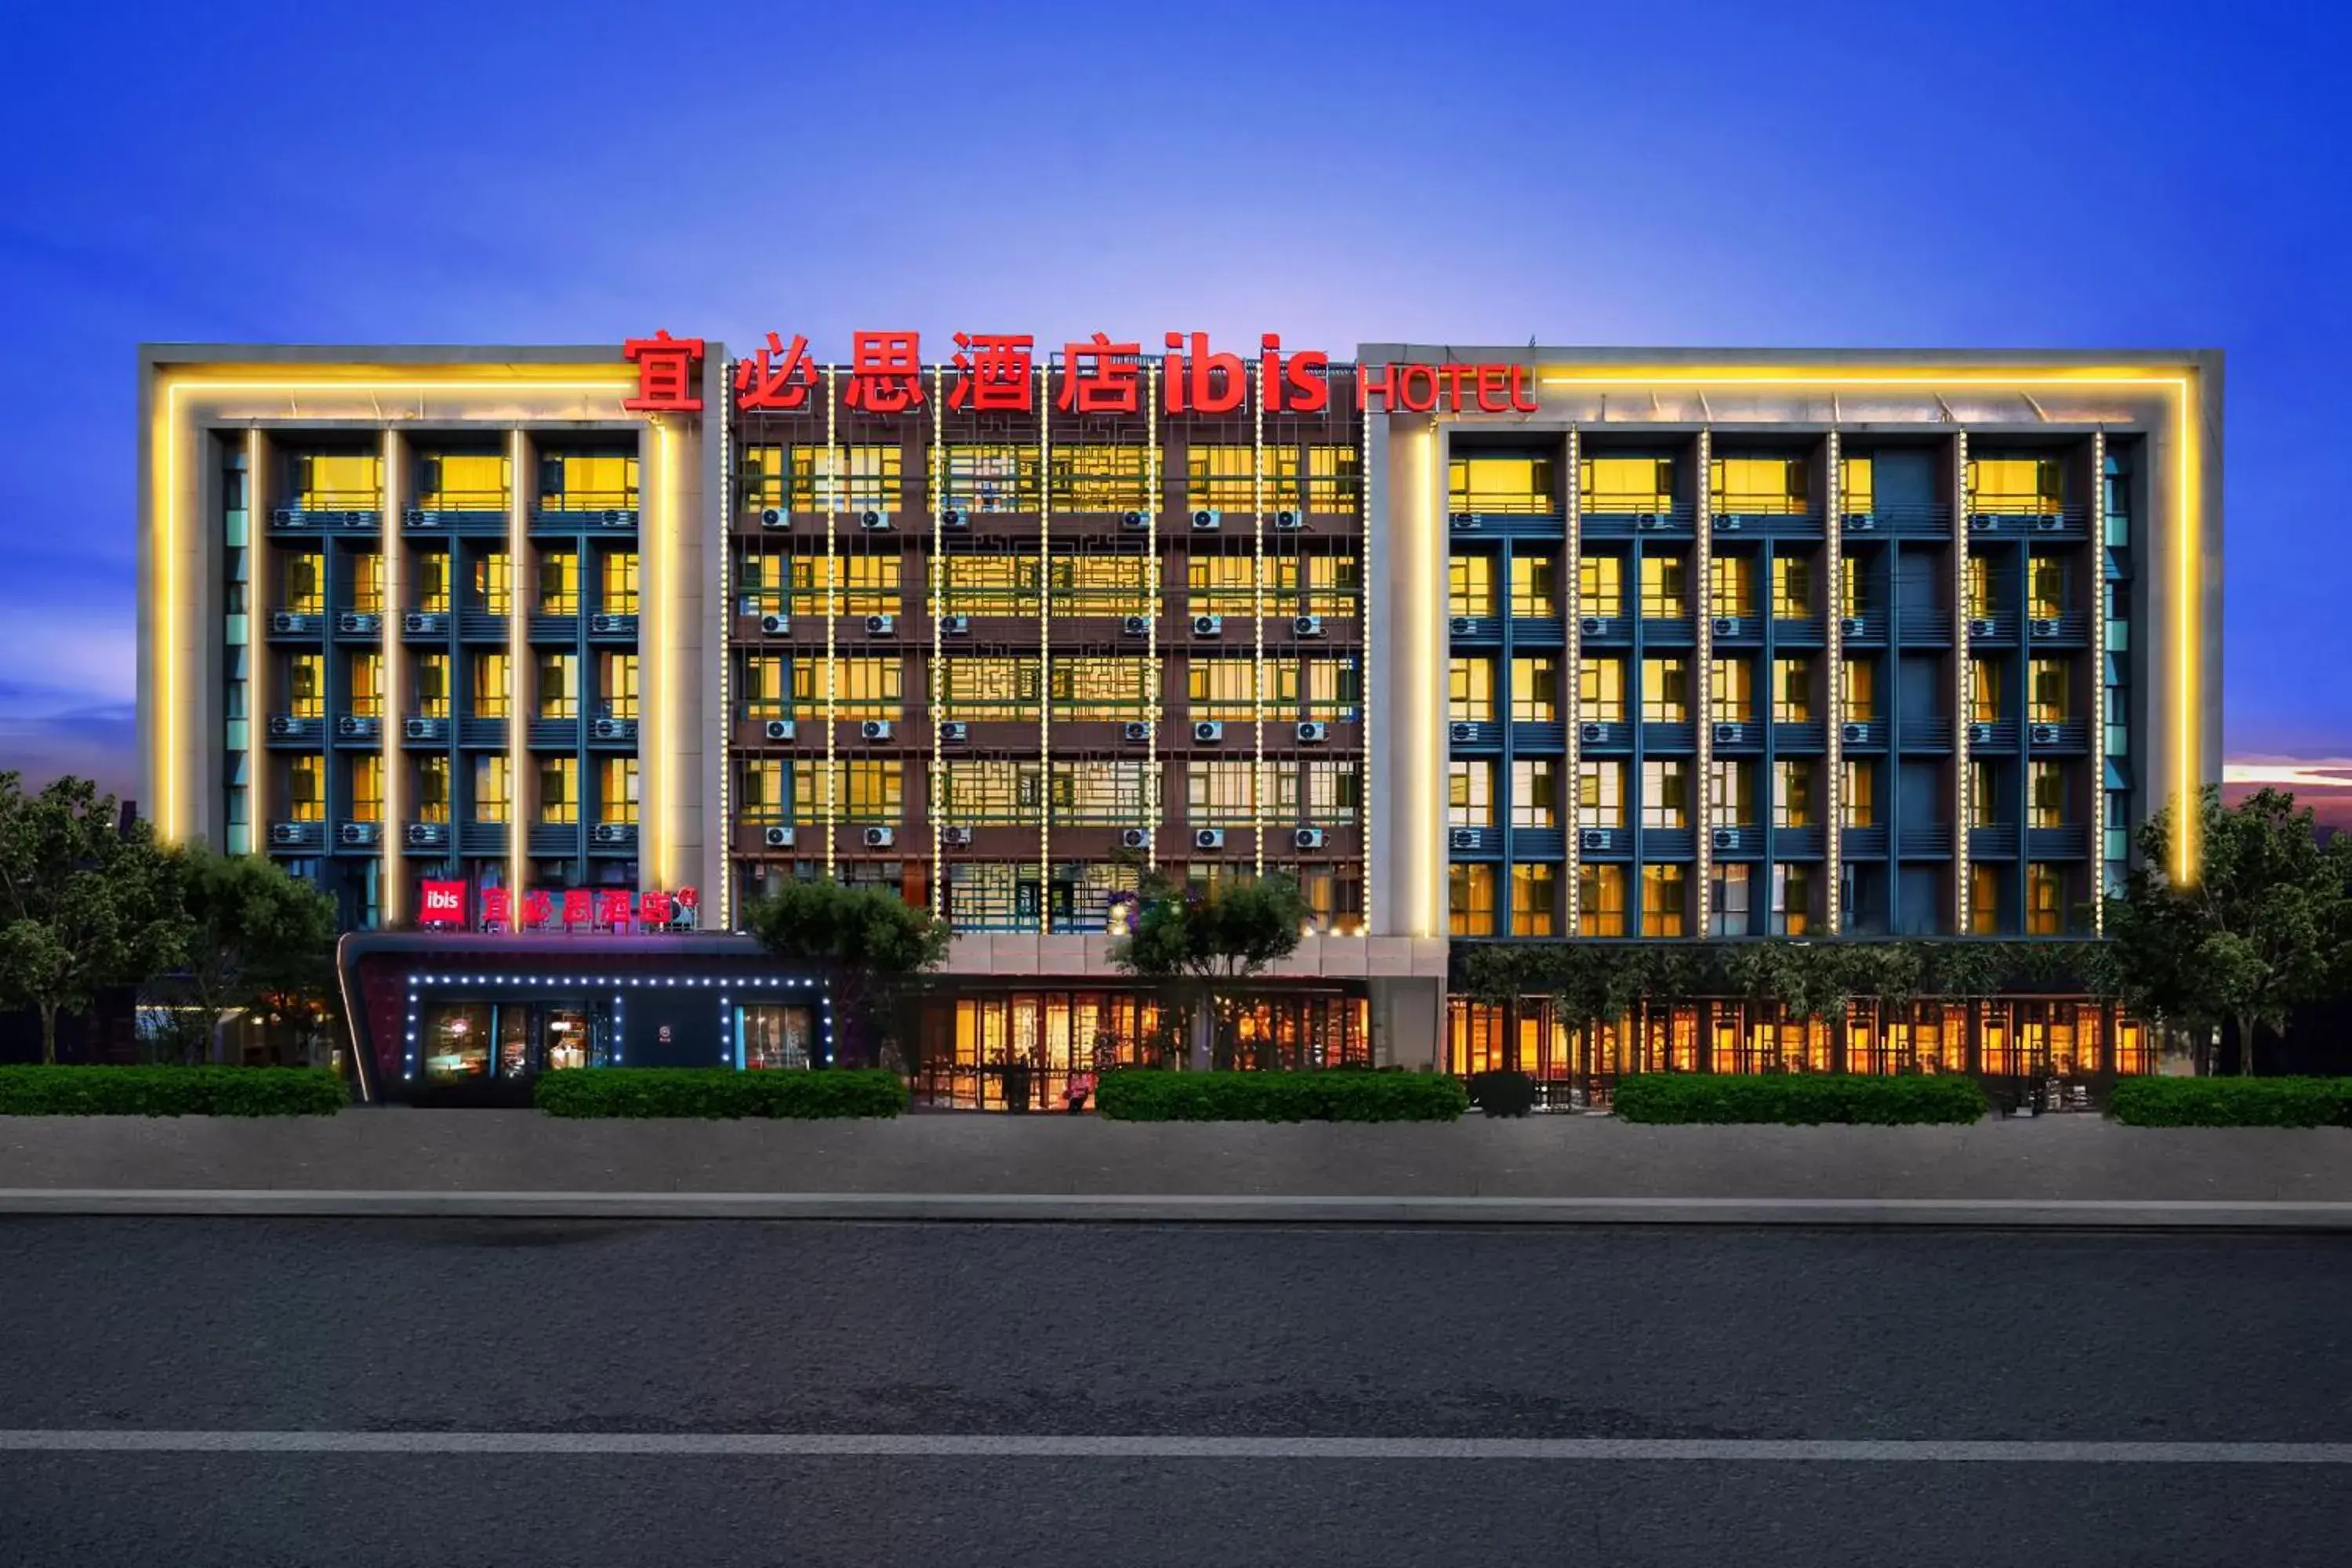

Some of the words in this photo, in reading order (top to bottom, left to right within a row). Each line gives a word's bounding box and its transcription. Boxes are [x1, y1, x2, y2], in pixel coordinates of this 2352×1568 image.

[624, 330, 1141, 414] 宜必思酒店
[1164, 332, 1330, 414] ibis
[1356, 363, 1540, 413] HOTEL
[427, 891, 458, 909] ibis
